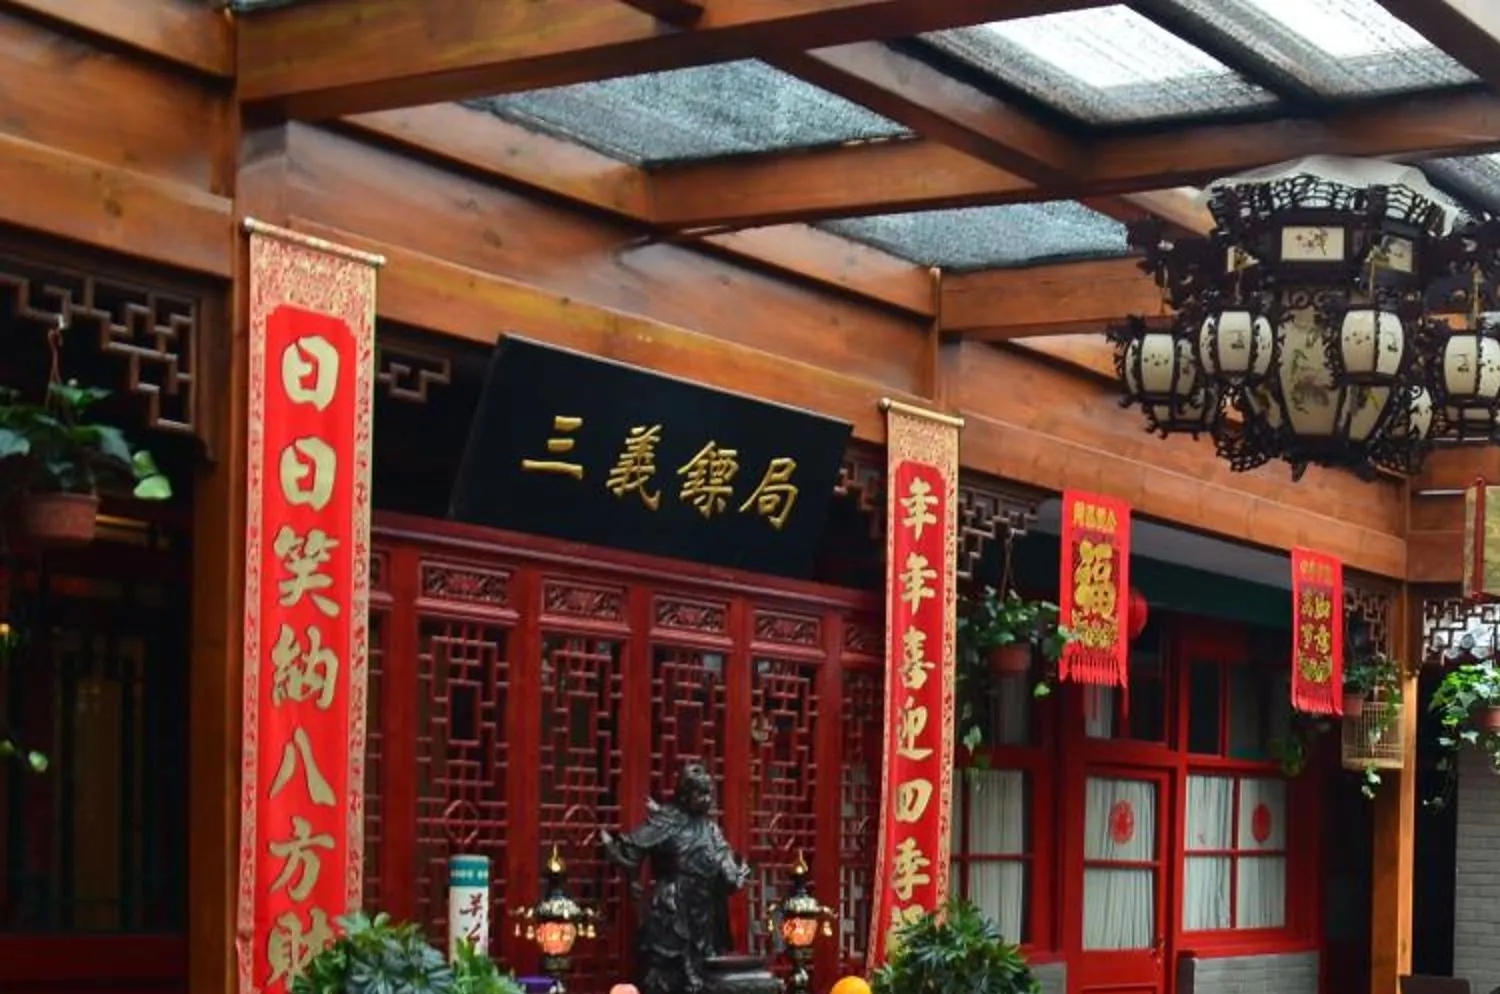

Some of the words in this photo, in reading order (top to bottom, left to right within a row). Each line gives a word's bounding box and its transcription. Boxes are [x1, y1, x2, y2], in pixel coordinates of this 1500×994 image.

[522, 415, 799, 529] 三義鏢局
[1075, 537, 1116, 620] 福
